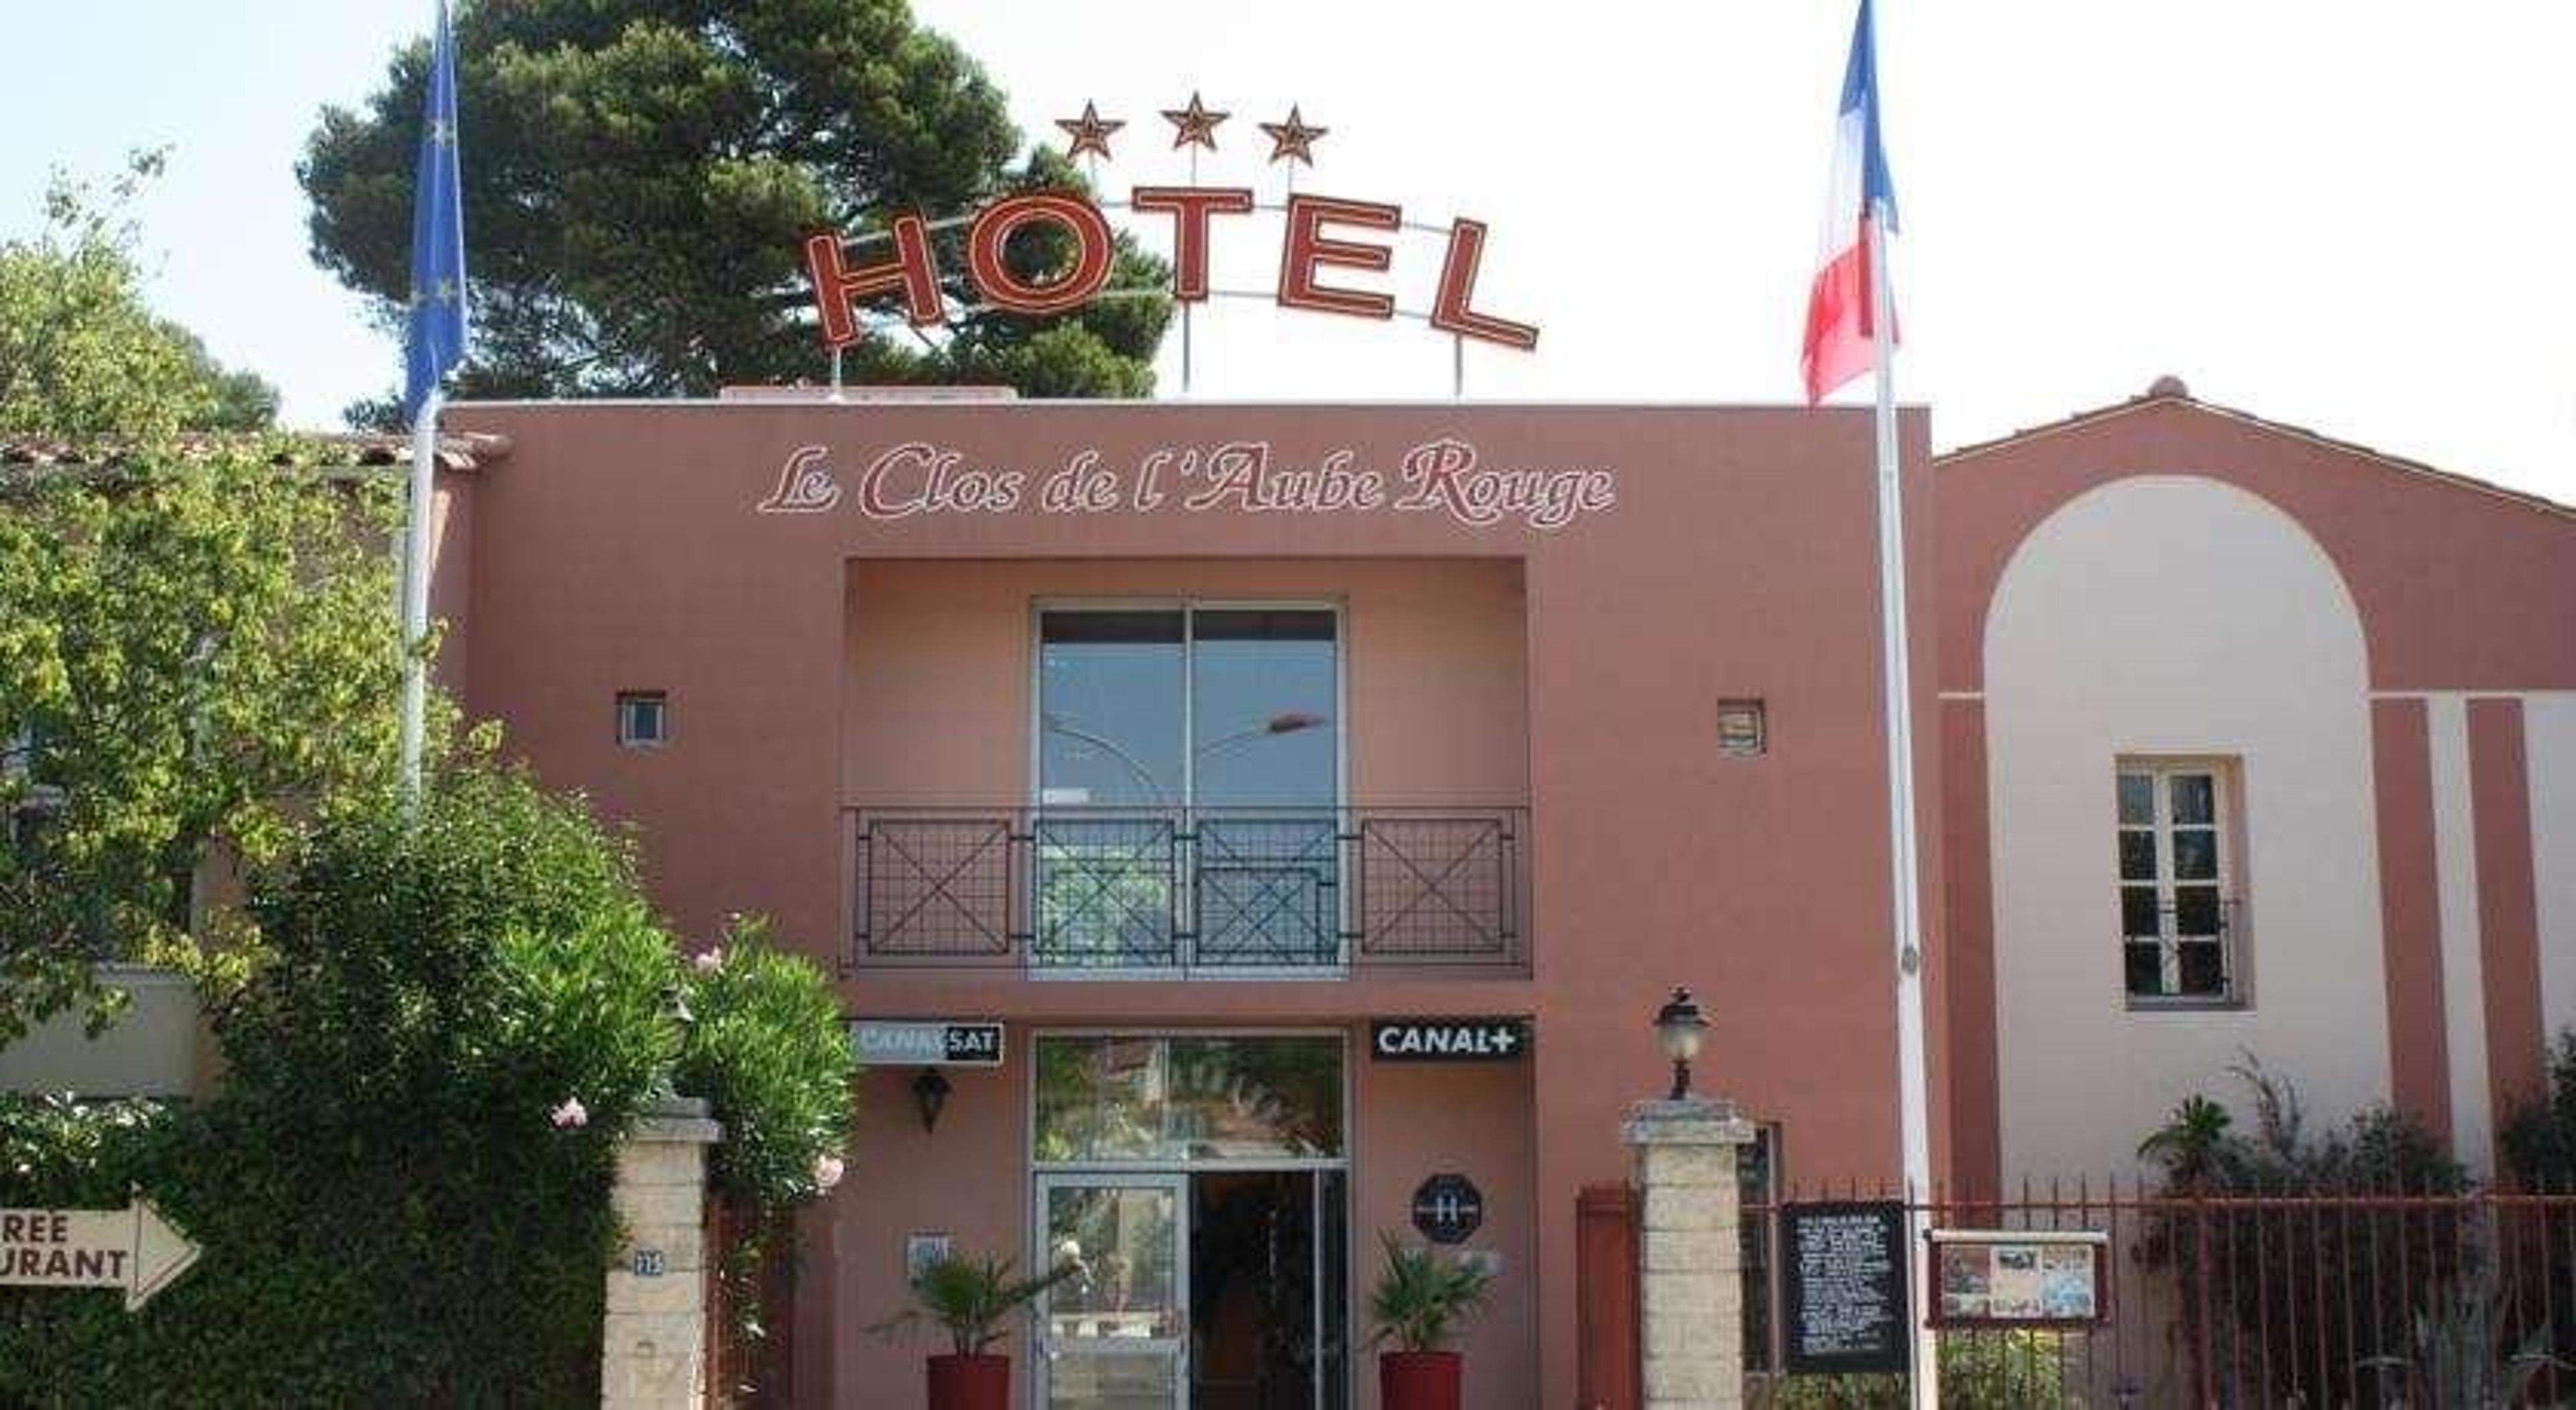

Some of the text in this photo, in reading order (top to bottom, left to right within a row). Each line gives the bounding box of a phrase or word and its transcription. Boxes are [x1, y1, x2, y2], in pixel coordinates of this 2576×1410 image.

[805, 185, 1540, 351] HOTEL
[757, 445, 840, 512] Le
[859, 441, 1025, 519] Clos
[1042, 450, 1120, 511] de
[1394, 437, 1616, 529] Rouge
[1379, 1026, 1516, 1053] CANAL+
